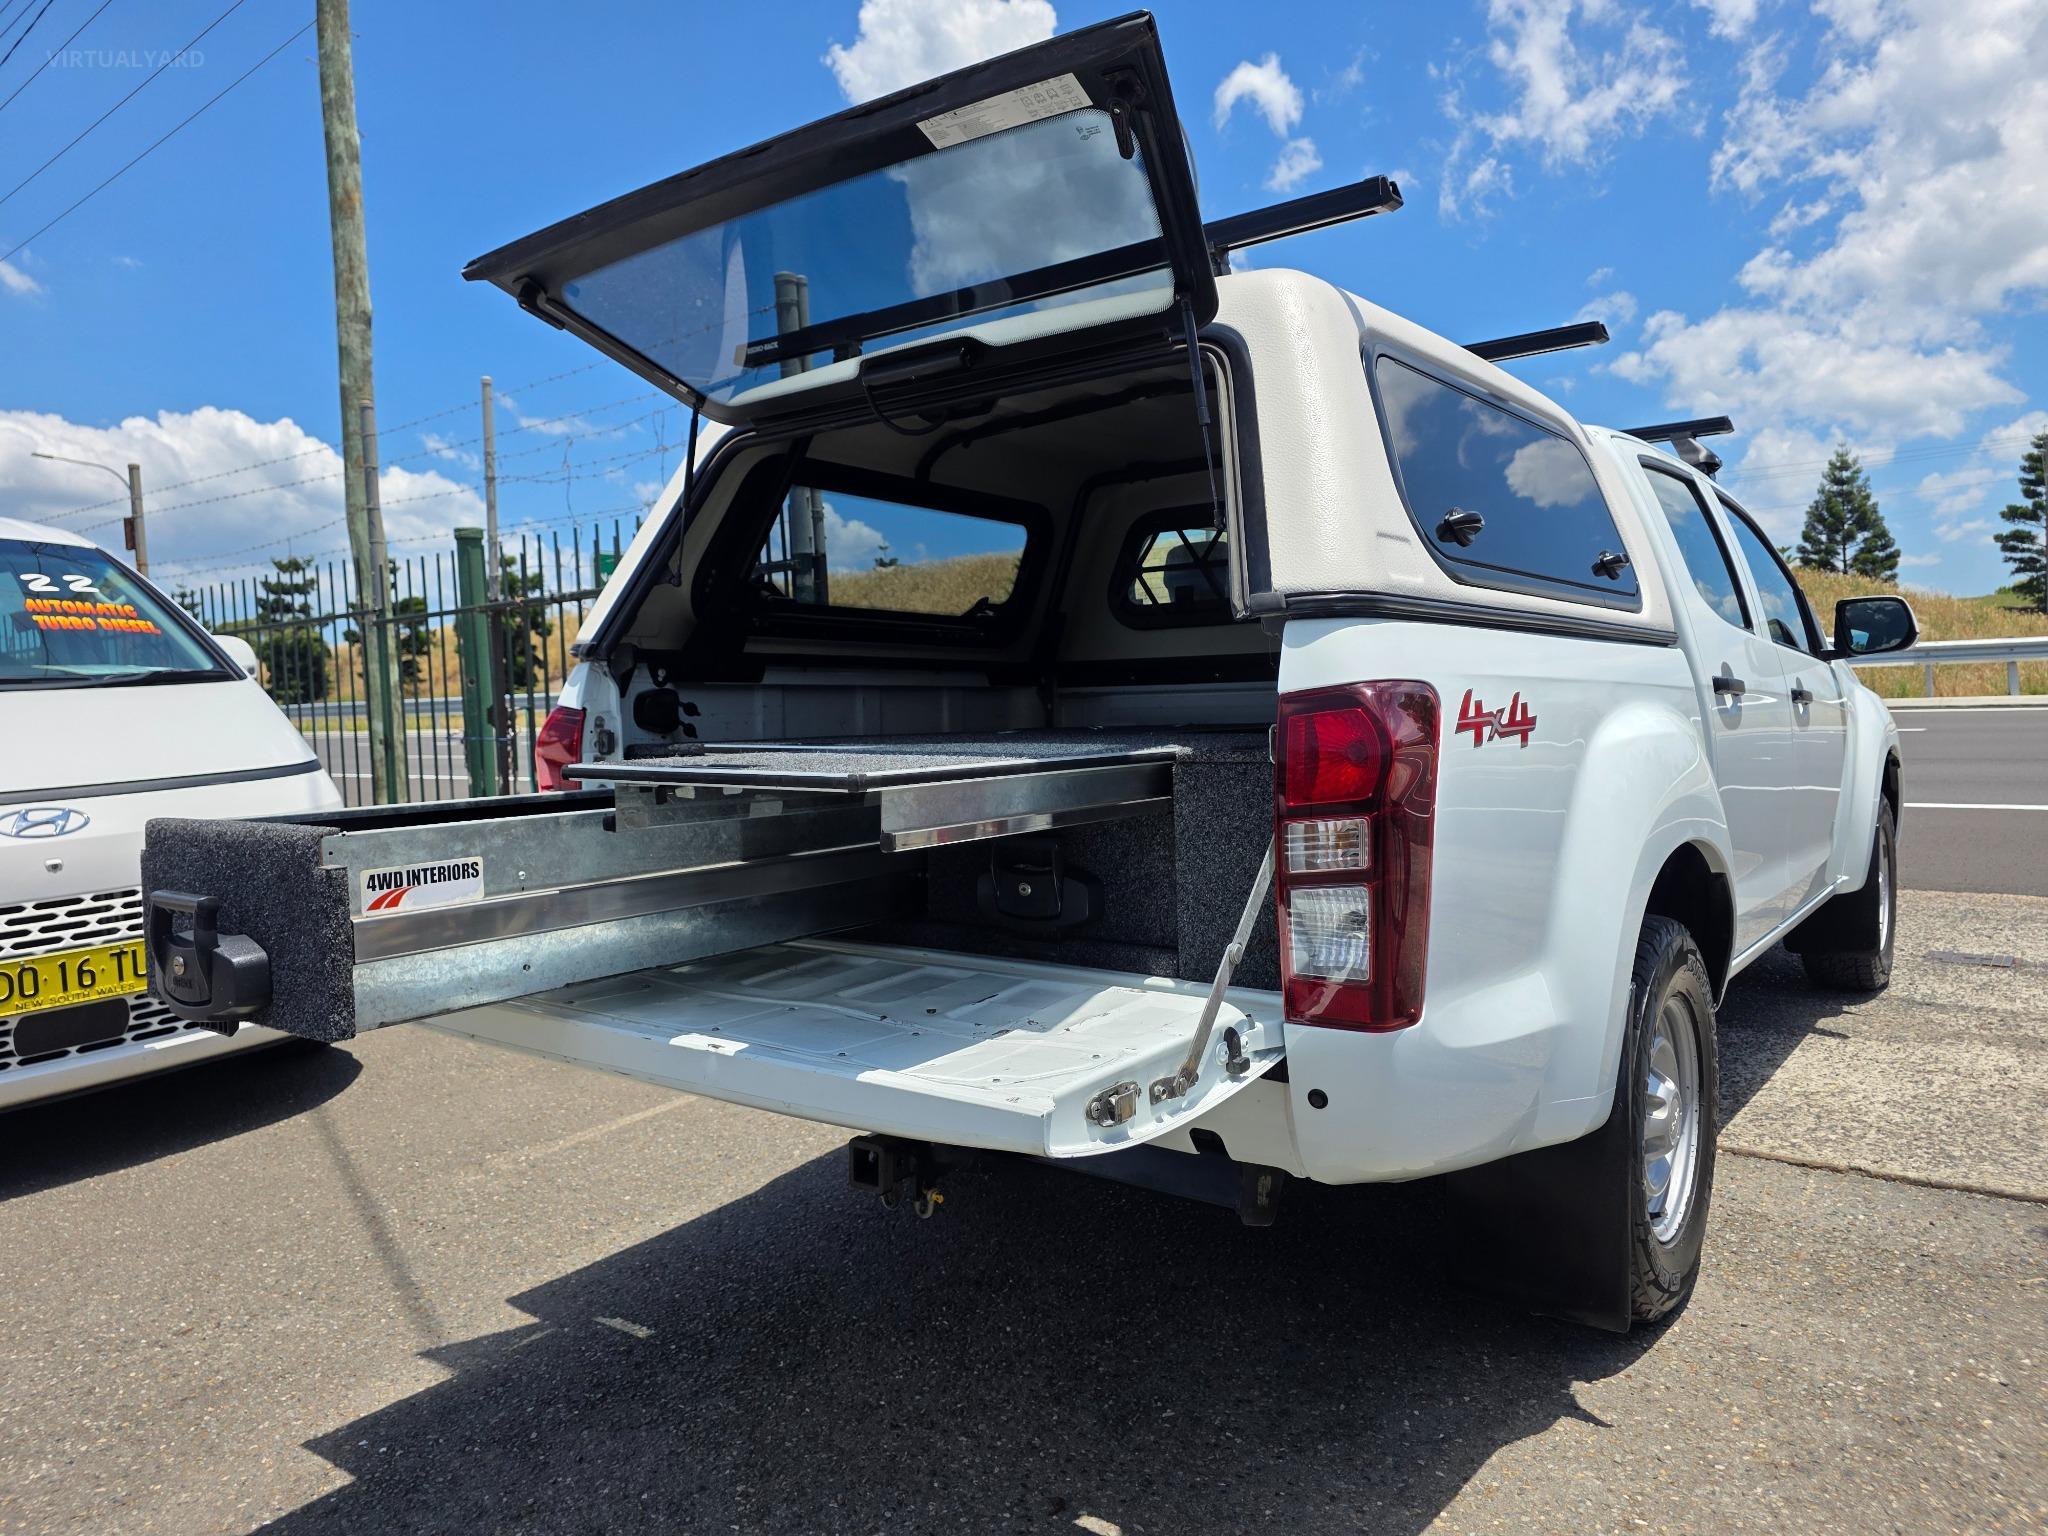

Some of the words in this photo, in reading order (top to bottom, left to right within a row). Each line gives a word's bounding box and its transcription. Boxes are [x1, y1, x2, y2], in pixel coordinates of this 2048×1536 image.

[25, 598, 138, 618] AUTOMATIC
[32, 615, 97, 630] TURBO
[97, 617, 161, 635] DIESEL
[366, 871, 404, 892] 4WD
[406, 861, 480, 887] INTERIORS
[14, 997, 44, 1011] NEW
[48, 990, 91, 1005] SOUTH
[96, 982, 136, 996] WALES
